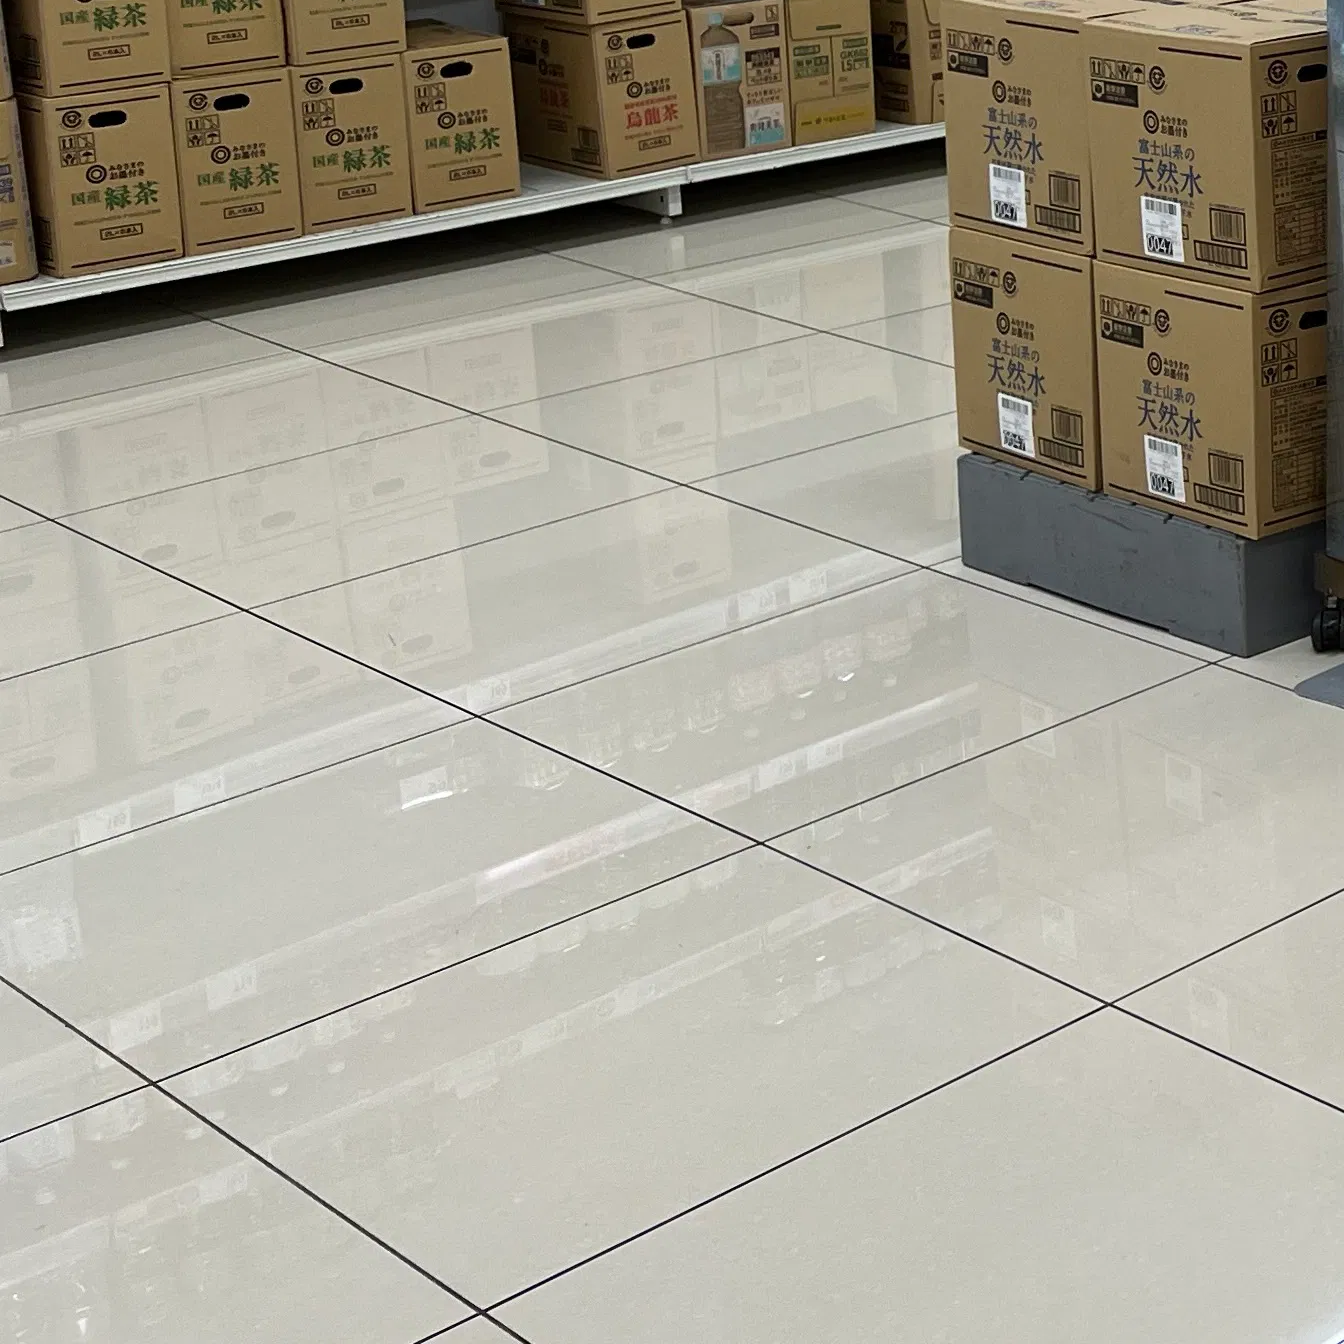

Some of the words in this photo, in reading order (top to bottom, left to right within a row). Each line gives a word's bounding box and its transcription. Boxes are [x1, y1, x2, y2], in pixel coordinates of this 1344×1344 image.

[626, 104, 679, 130] 烏龍茶
[987, 107, 1037, 130] 富士山系の
[982, 124, 1044, 164] 天然水
[1138, 138, 1195, 161] 富士山系の
[1132, 156, 1204, 198] 天然水
[1148, 233, 1174, 256] 0047
[991, 338, 1040, 362] 富士山系の
[986, 353, 1047, 397] 天然水
[1142, 379, 1196, 405] 富士山系の
[1137, 396, 1203, 441] 天然水
[1151, 473, 1175, 496] 0047
